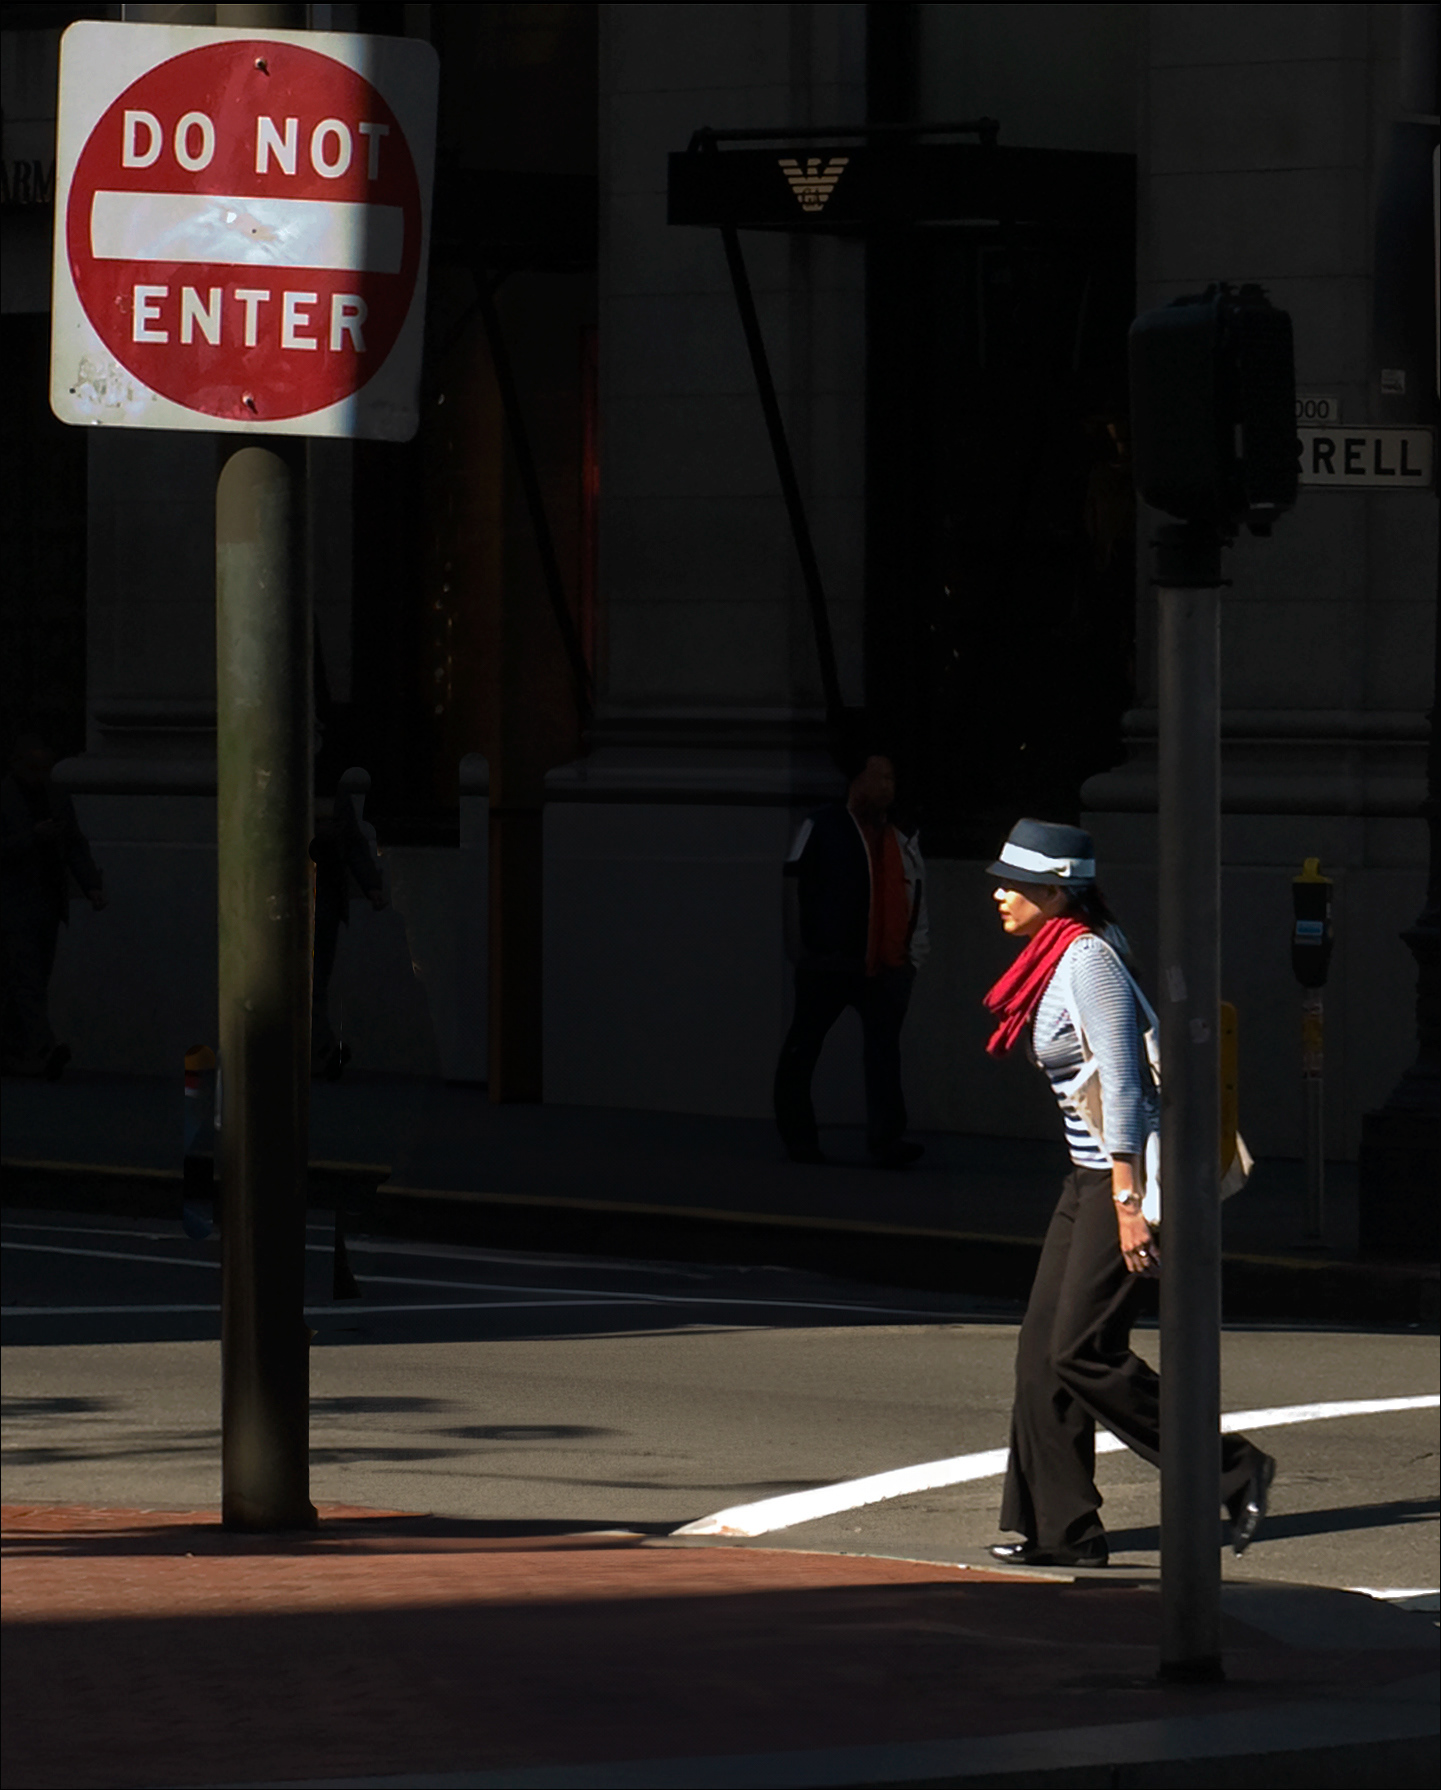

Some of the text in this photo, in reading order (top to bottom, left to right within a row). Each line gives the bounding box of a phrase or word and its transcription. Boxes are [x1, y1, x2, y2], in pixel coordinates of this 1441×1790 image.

[122, 109, 390, 180] DO NOT
[132, 284, 369, 353] ENTER
